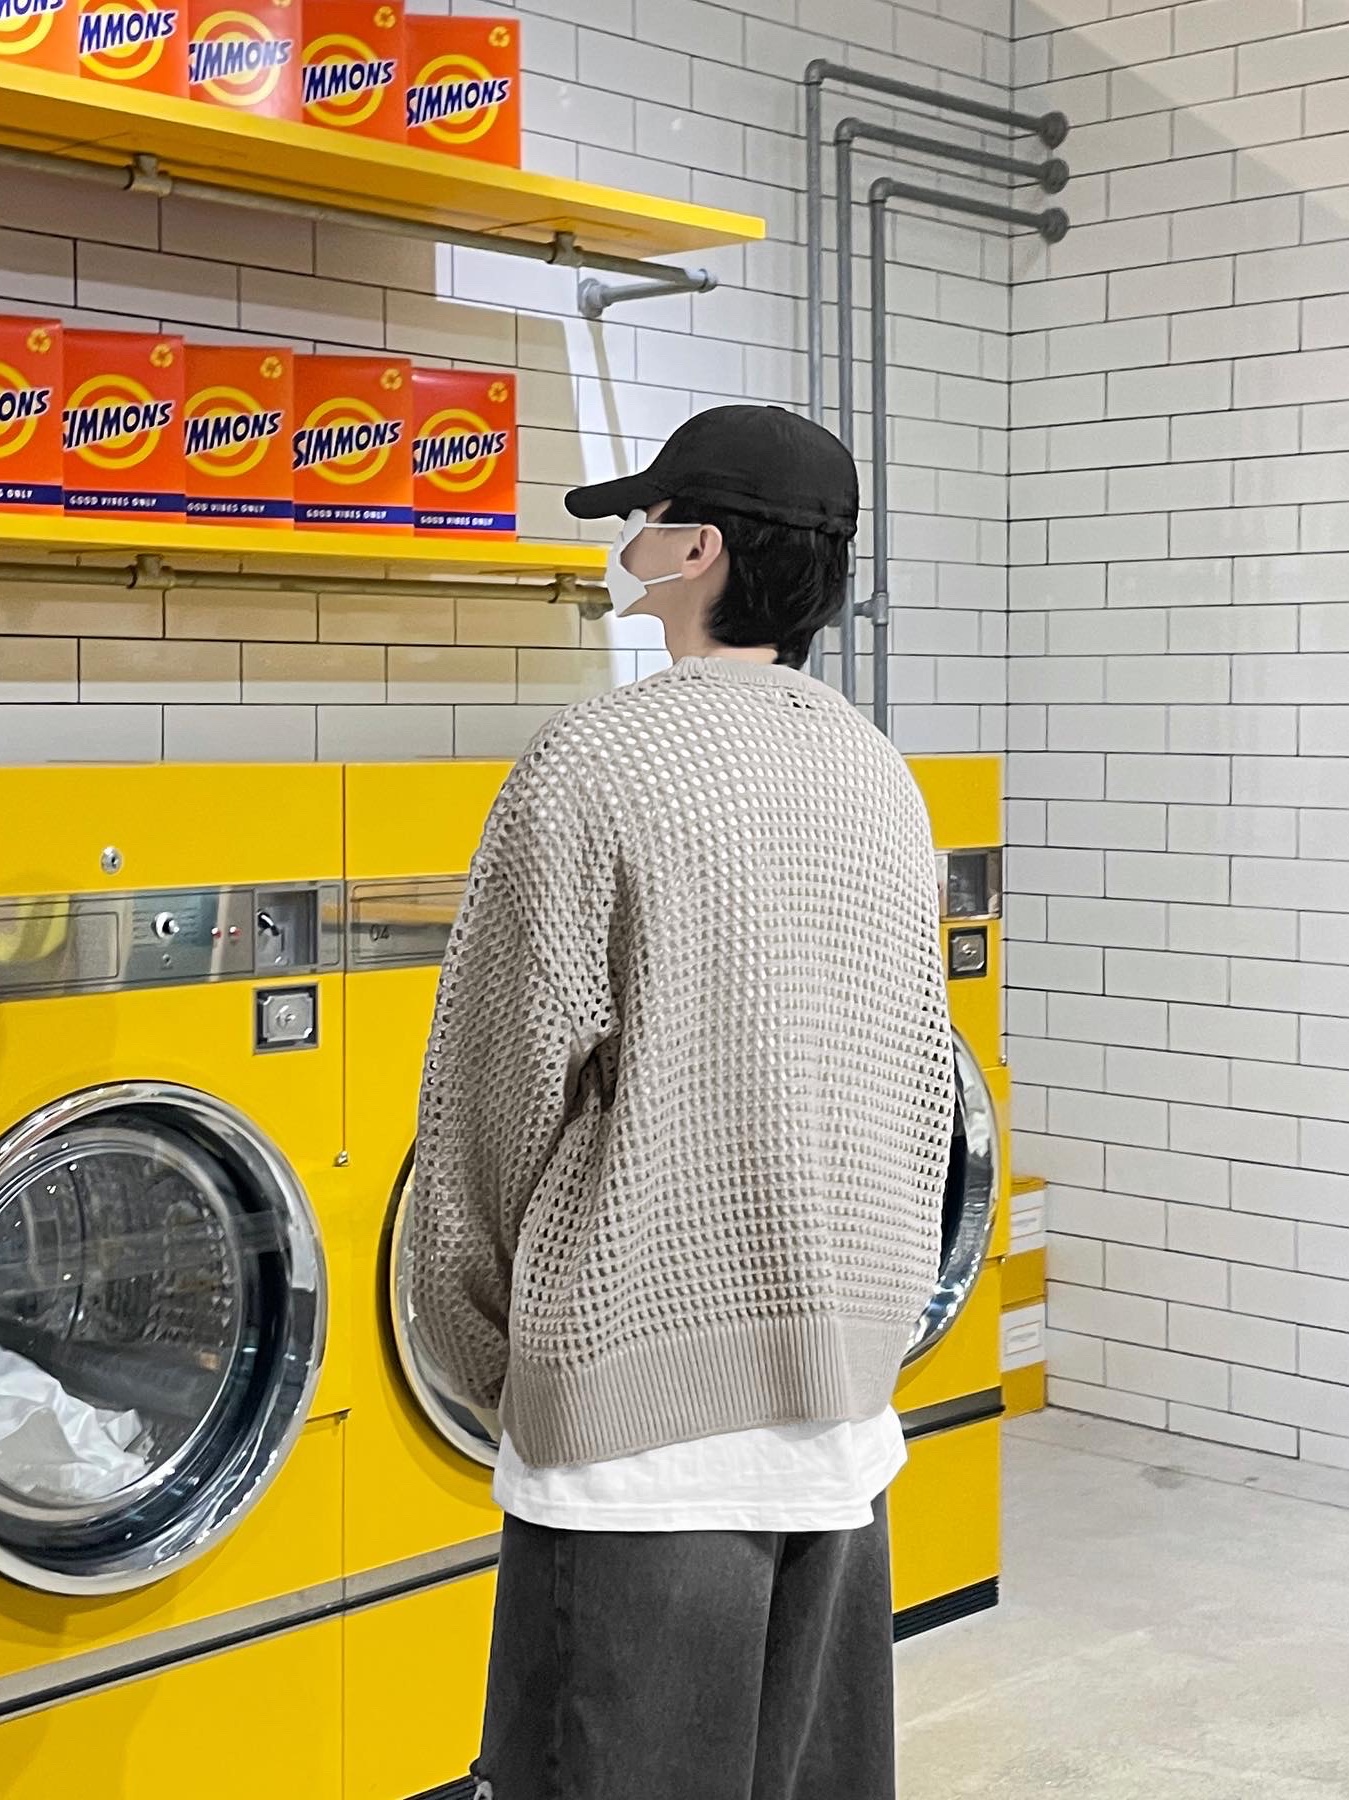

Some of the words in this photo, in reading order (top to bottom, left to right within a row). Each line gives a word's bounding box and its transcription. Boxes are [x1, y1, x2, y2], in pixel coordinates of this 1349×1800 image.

[78, 12, 176, 54] MMONS
[406, 79, 509, 127] SIMMONS
[292, 421, 402, 470] SIMMONS
[412, 432, 506, 475] SIMMONS
